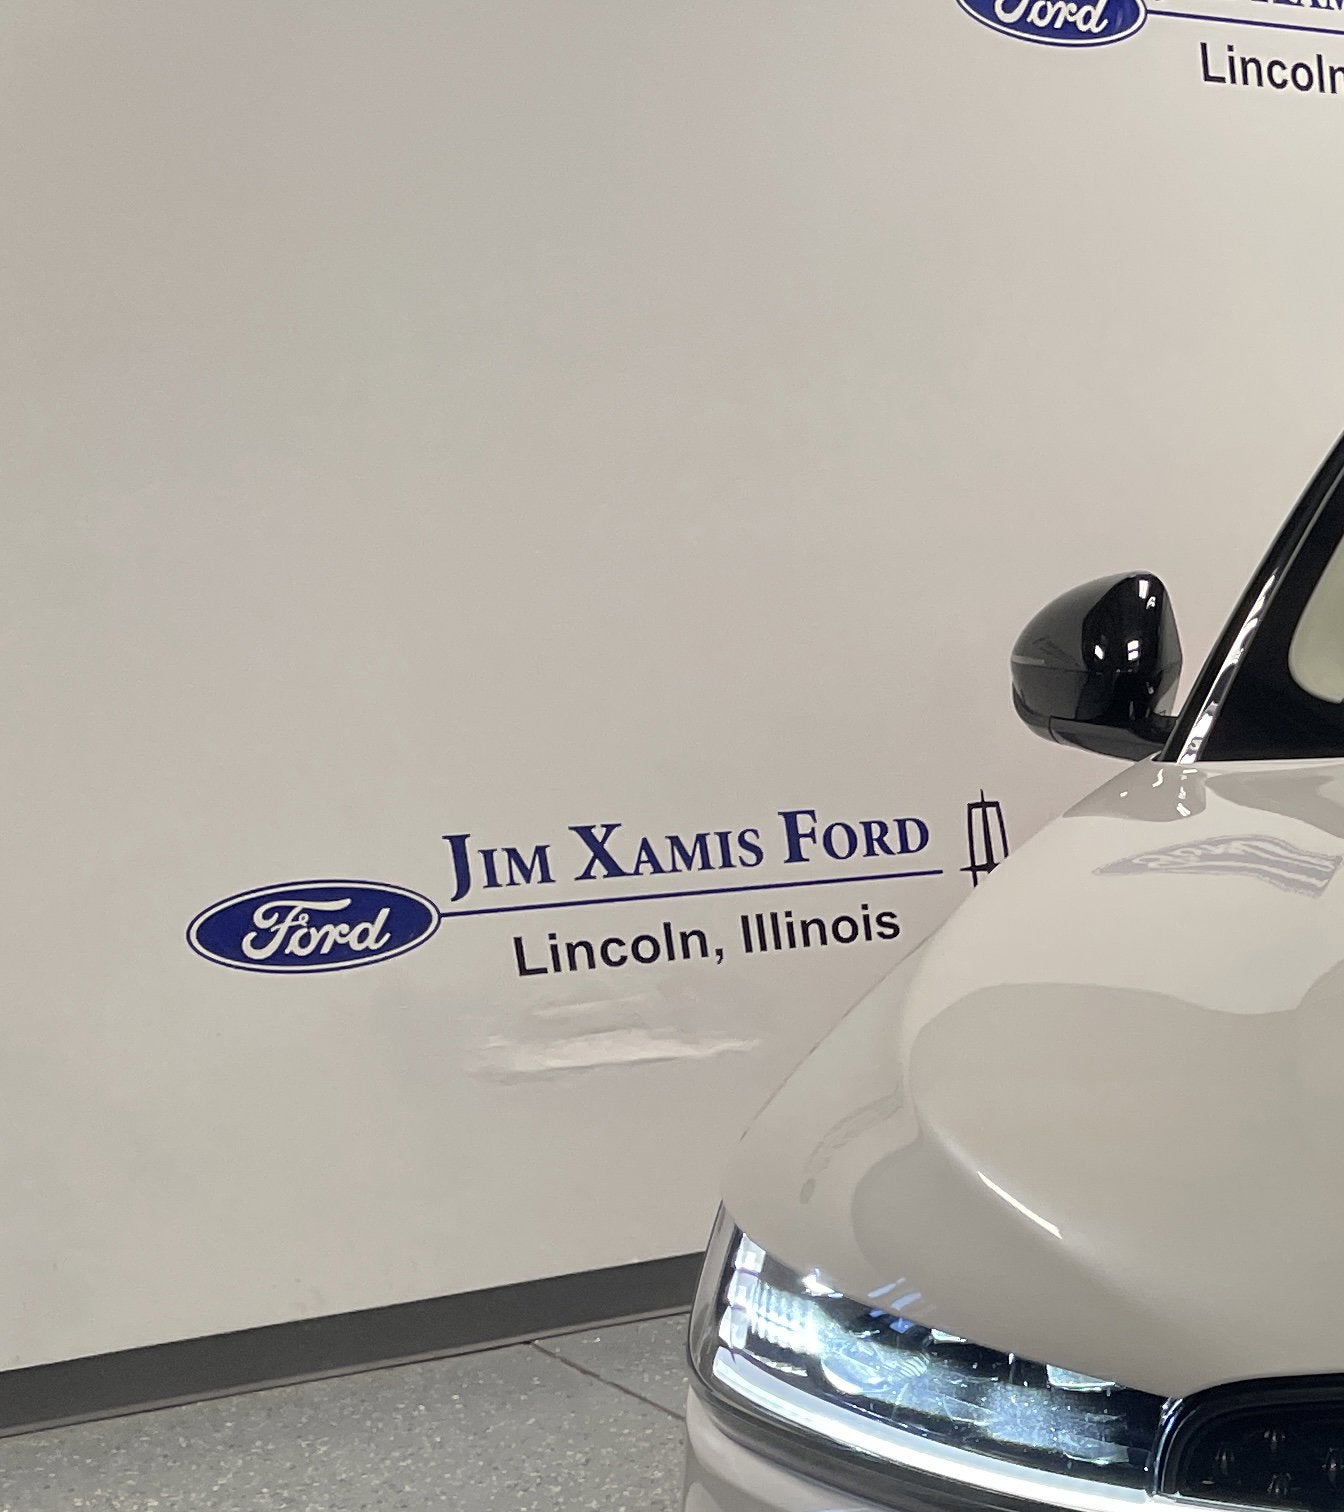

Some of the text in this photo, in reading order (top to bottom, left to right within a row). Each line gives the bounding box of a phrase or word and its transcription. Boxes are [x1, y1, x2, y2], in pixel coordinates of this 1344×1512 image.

[442, 809, 930, 902] JIM XAMIS FORD
[241, 898, 392, 960] Ford
[513, 904, 901, 977] Lincoln, Illinois
